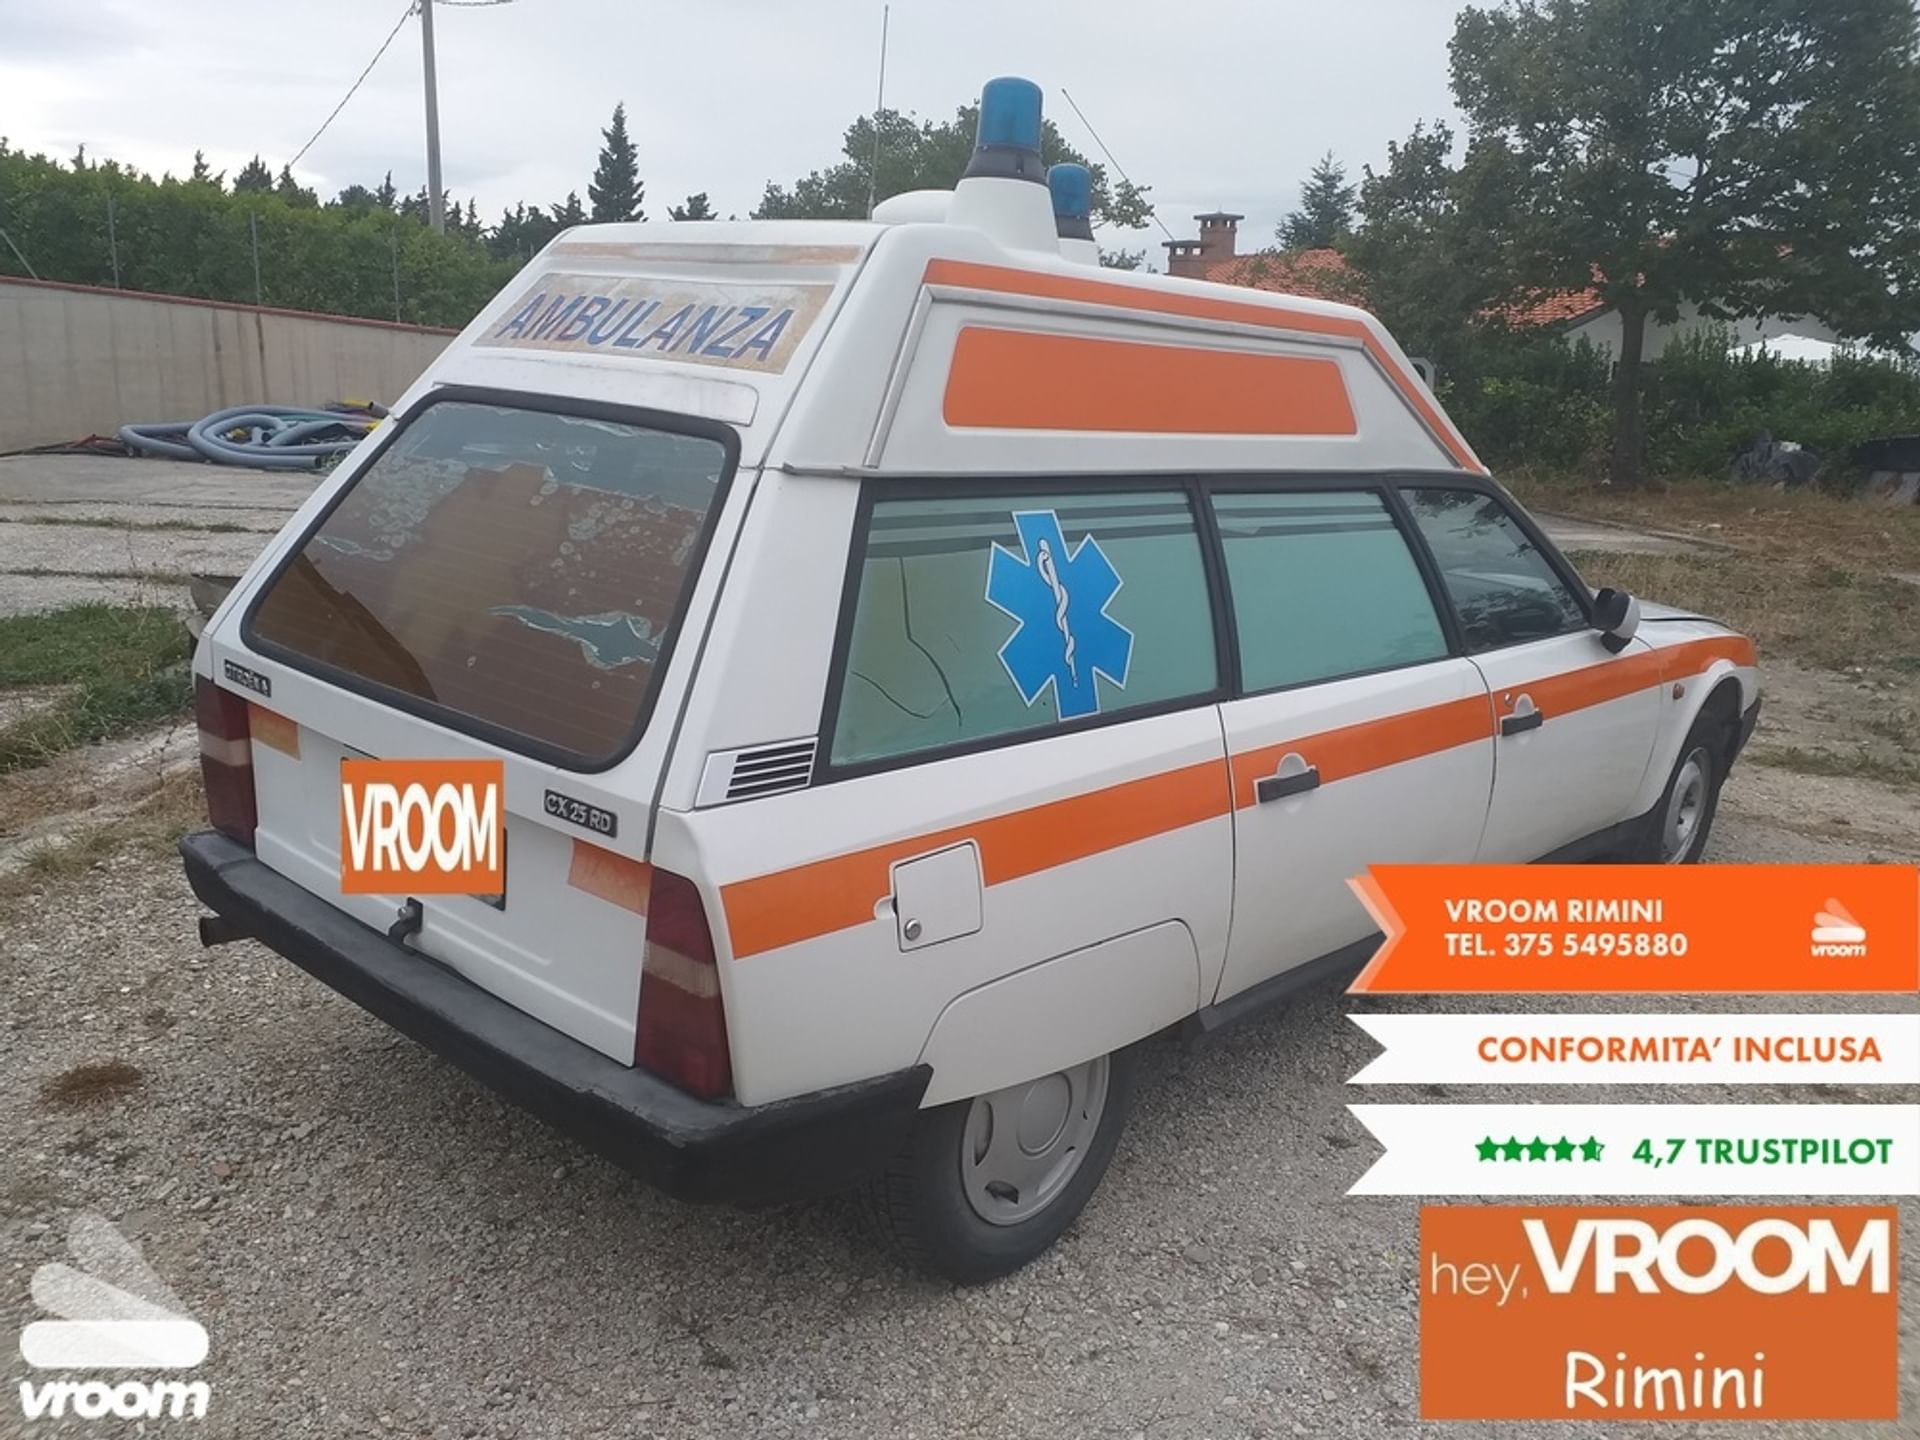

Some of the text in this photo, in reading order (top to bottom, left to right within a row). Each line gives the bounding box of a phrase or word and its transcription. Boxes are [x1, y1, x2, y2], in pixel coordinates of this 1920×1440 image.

[496, 293, 795, 361] AMBULANZA
[546, 794, 611, 832] CX 25 RD
